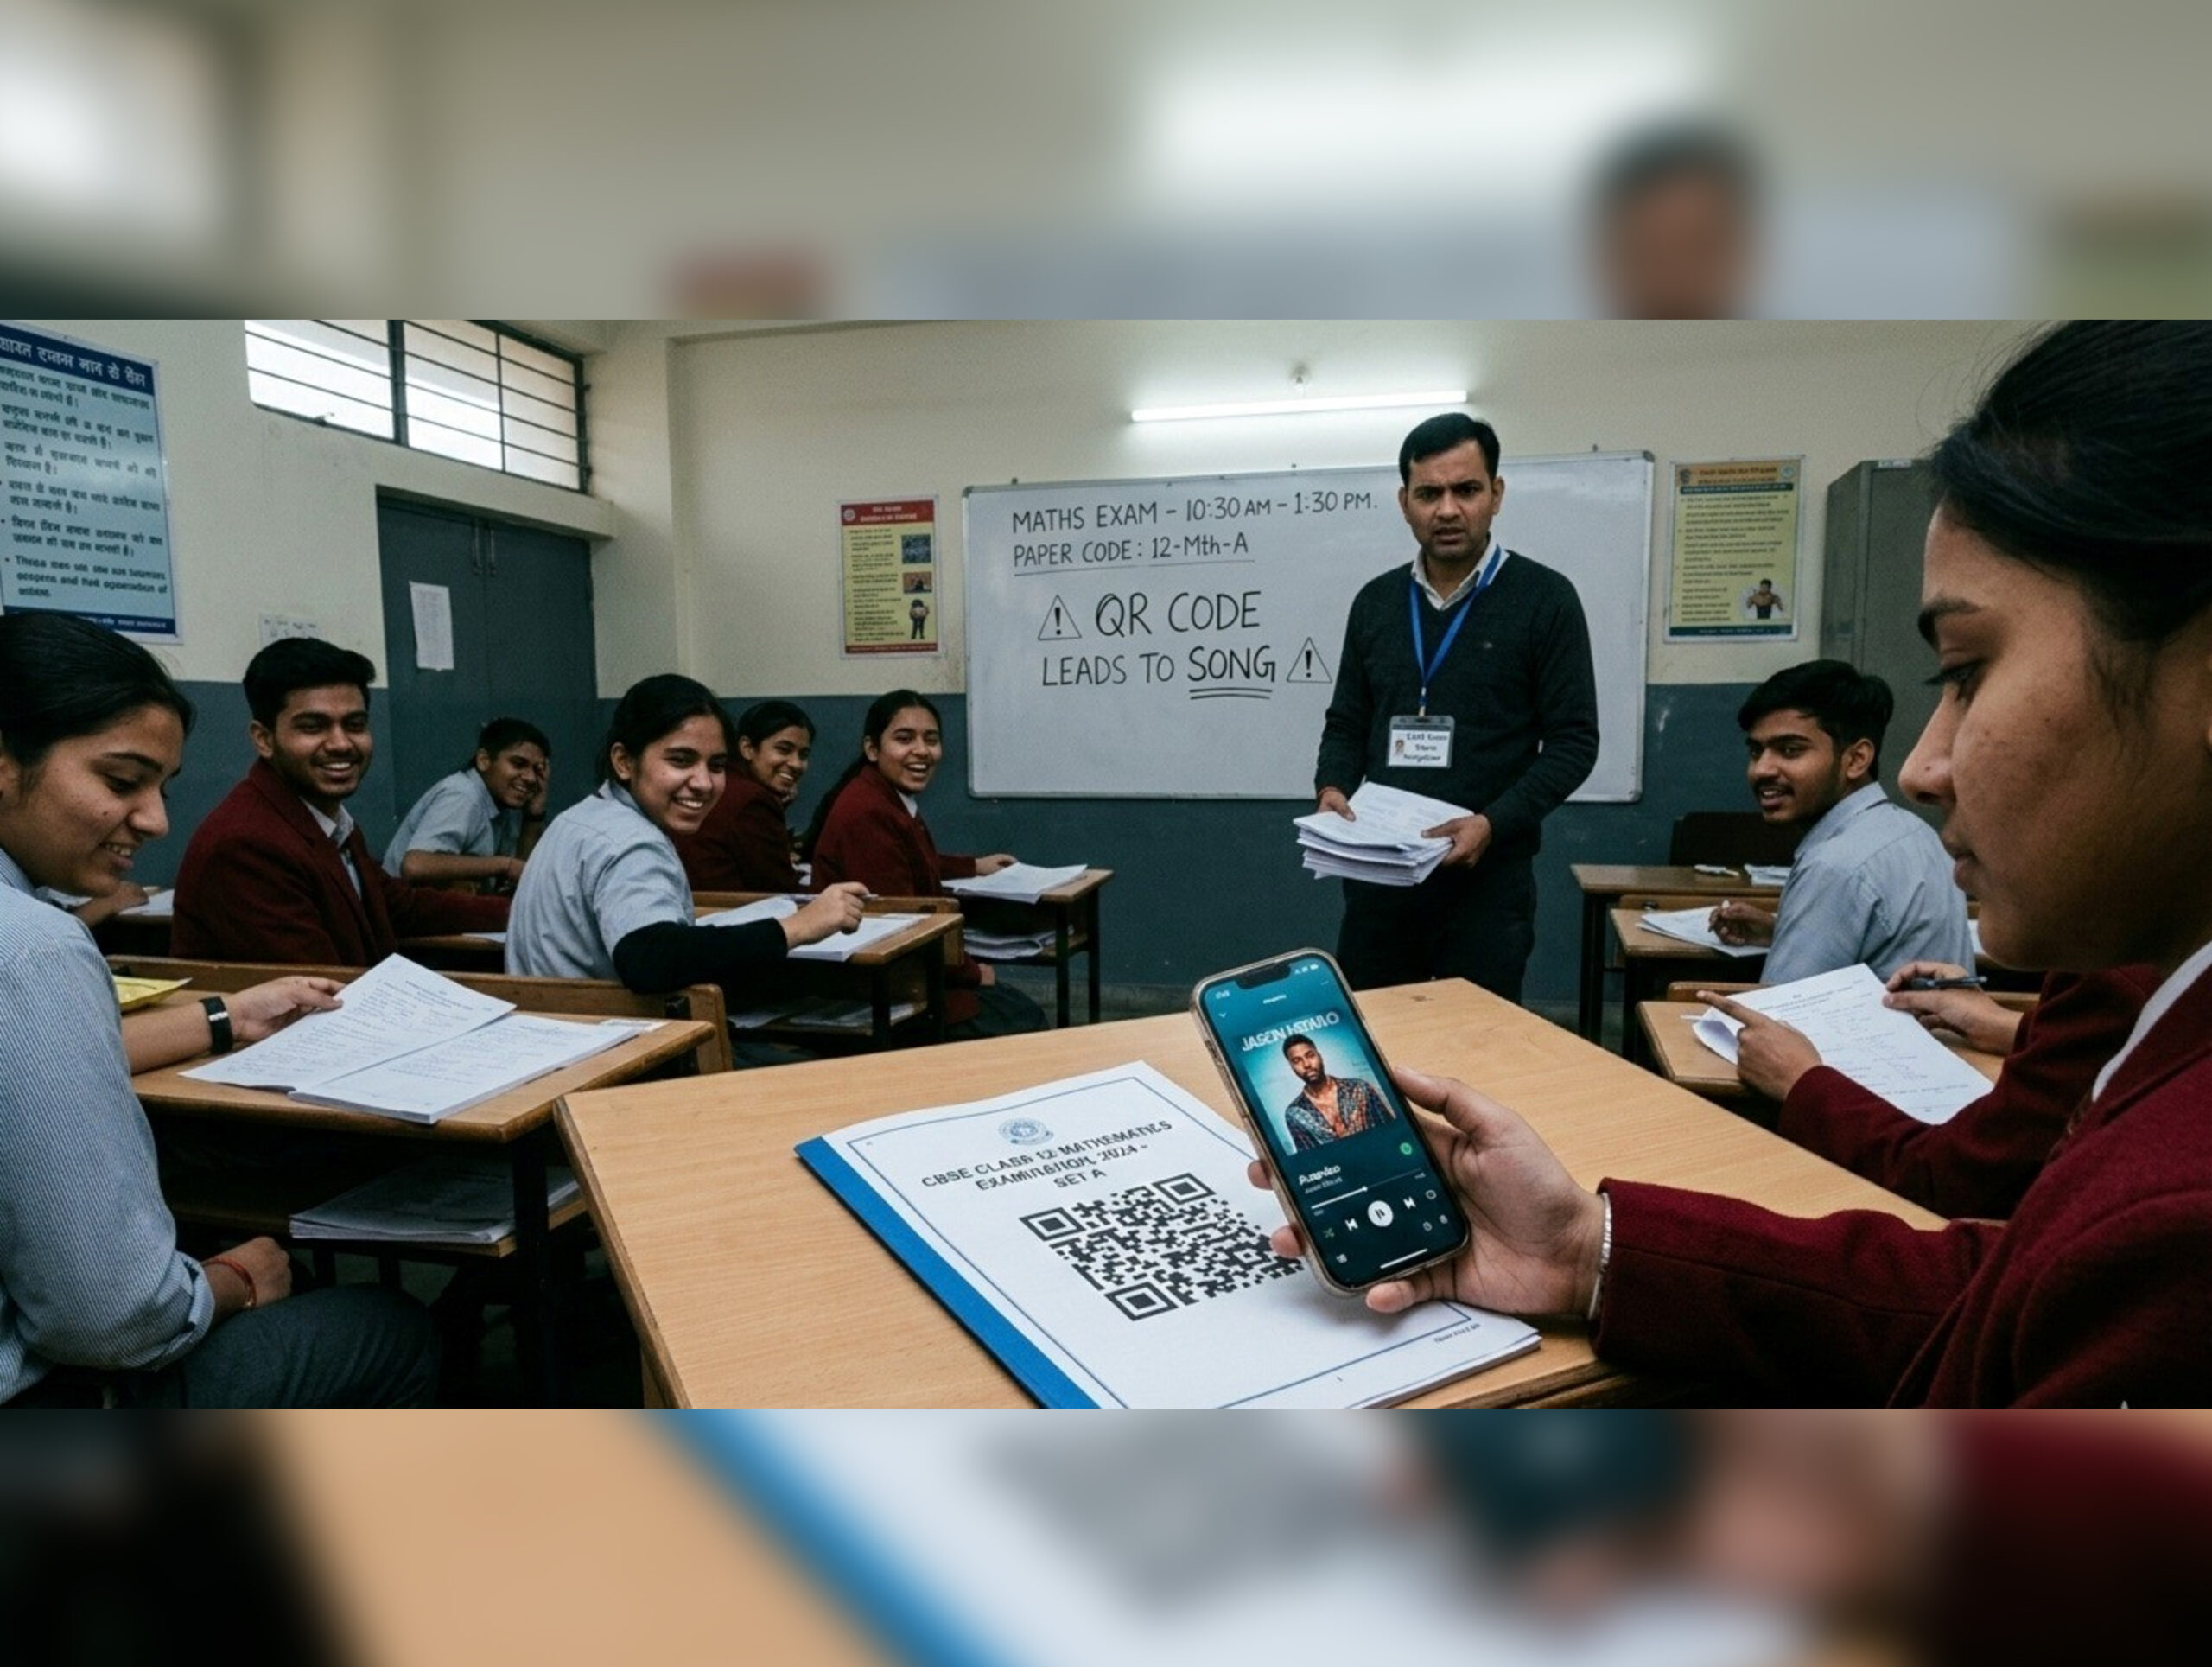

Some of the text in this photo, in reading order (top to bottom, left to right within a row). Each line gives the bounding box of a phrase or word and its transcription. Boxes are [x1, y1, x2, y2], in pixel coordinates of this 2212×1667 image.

[1012, 506, 1085, 533] MATHS
[1096, 501, 1158, 529] EXAM
[1186, 497, 1241, 521] 10:30
[1294, 491, 1338, 514] 1:30
[1014, 543, 1074, 567] PAPER
[1151, 531, 1249, 560] 12-Mth-A
[1095, 591, 1262, 638] QR CODE
[1042, 645, 1276, 686] LEADS TO SONG
[921, 1168, 974, 1187] CBSE
[1036, 1149, 1058, 1160] 12
[1053, 1168, 1107, 1188] SET A
